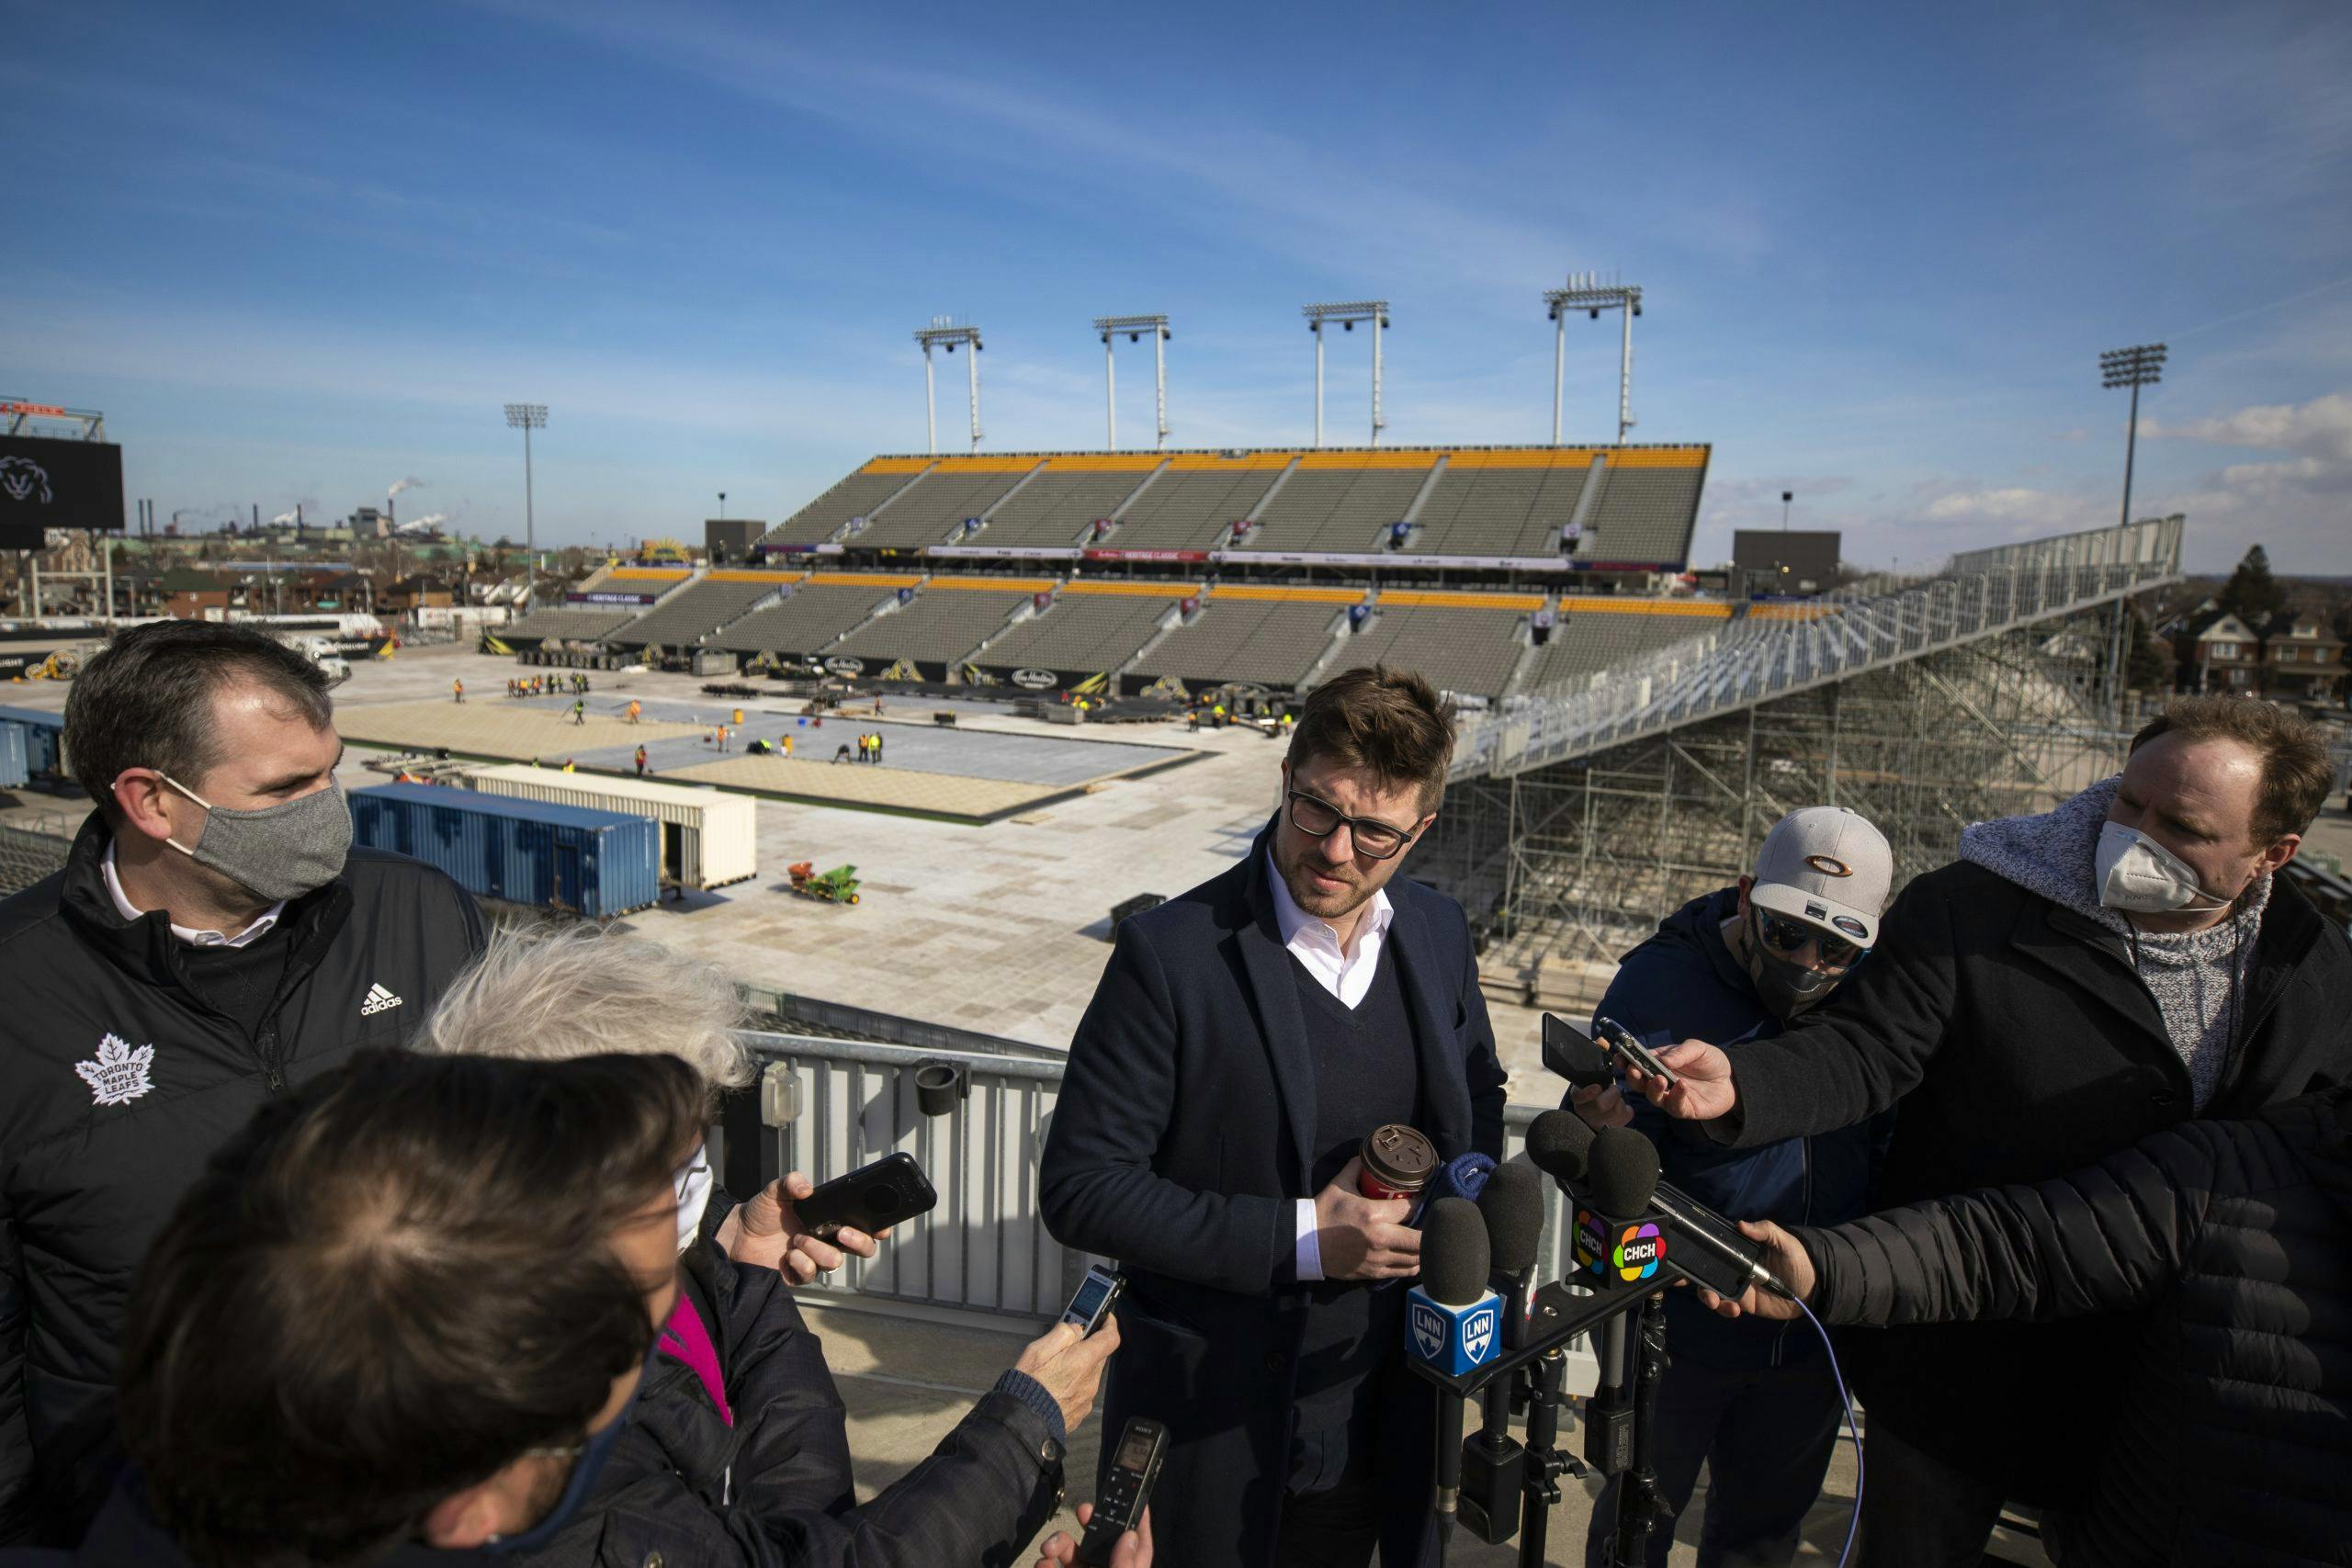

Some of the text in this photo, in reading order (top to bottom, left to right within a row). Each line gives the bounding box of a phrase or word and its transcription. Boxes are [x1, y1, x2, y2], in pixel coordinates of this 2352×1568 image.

[592, 594, 617, 603] HERITAGE
[617, 594, 640, 604] CLASSIC
[361, 997, 402, 1015] adidas
[93, 1063, 142, 1081] TORONTO
[103, 1071, 137, 1086] MAPLE
[105, 1079, 139, 1094] LEAFS
[1580, 1230, 1602, 1257] CHCH
[1623, 1243, 1656, 1261] CHCH
[1417, 1310, 1441, 1337] LNN
[1467, 1315, 1489, 1339] LNN
[1135, 1426, 1152, 1435] SONY
